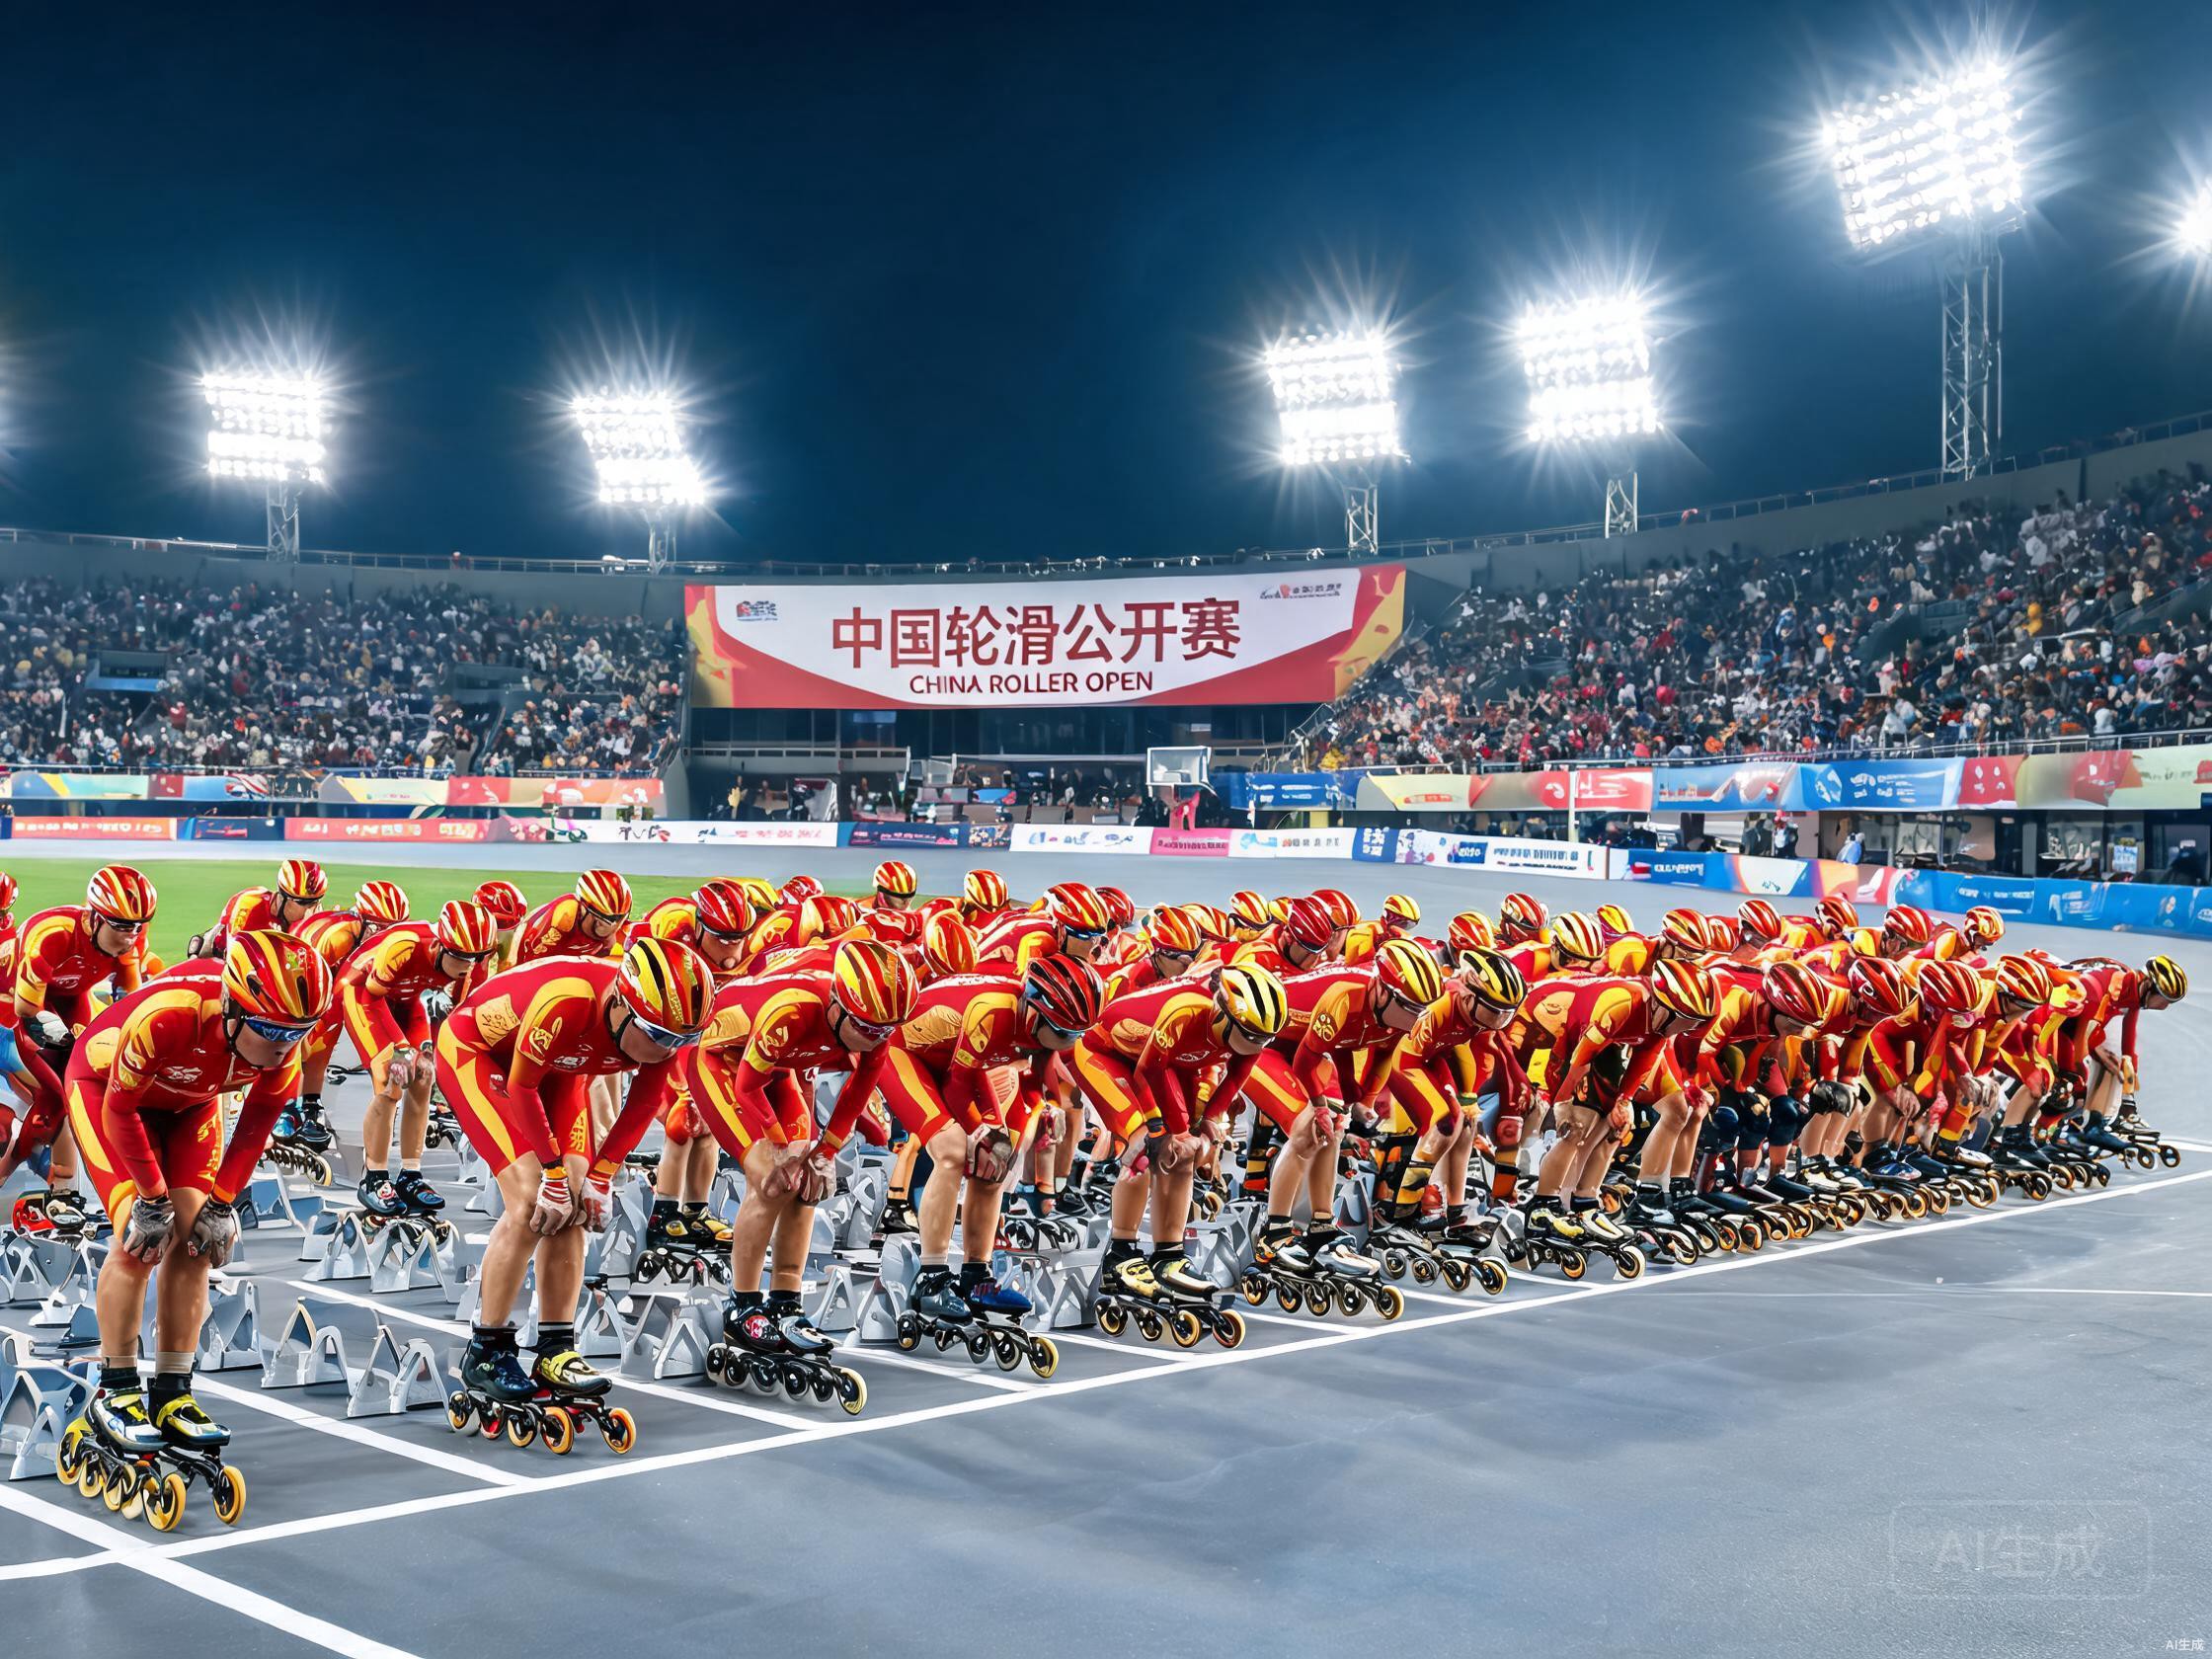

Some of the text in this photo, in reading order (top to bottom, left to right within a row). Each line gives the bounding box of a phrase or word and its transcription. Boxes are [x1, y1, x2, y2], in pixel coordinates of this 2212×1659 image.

[832, 597, 1240, 669] 中国轮滑公开赛
[909, 672, 1153, 694] CHINA ROLLER OPEN
